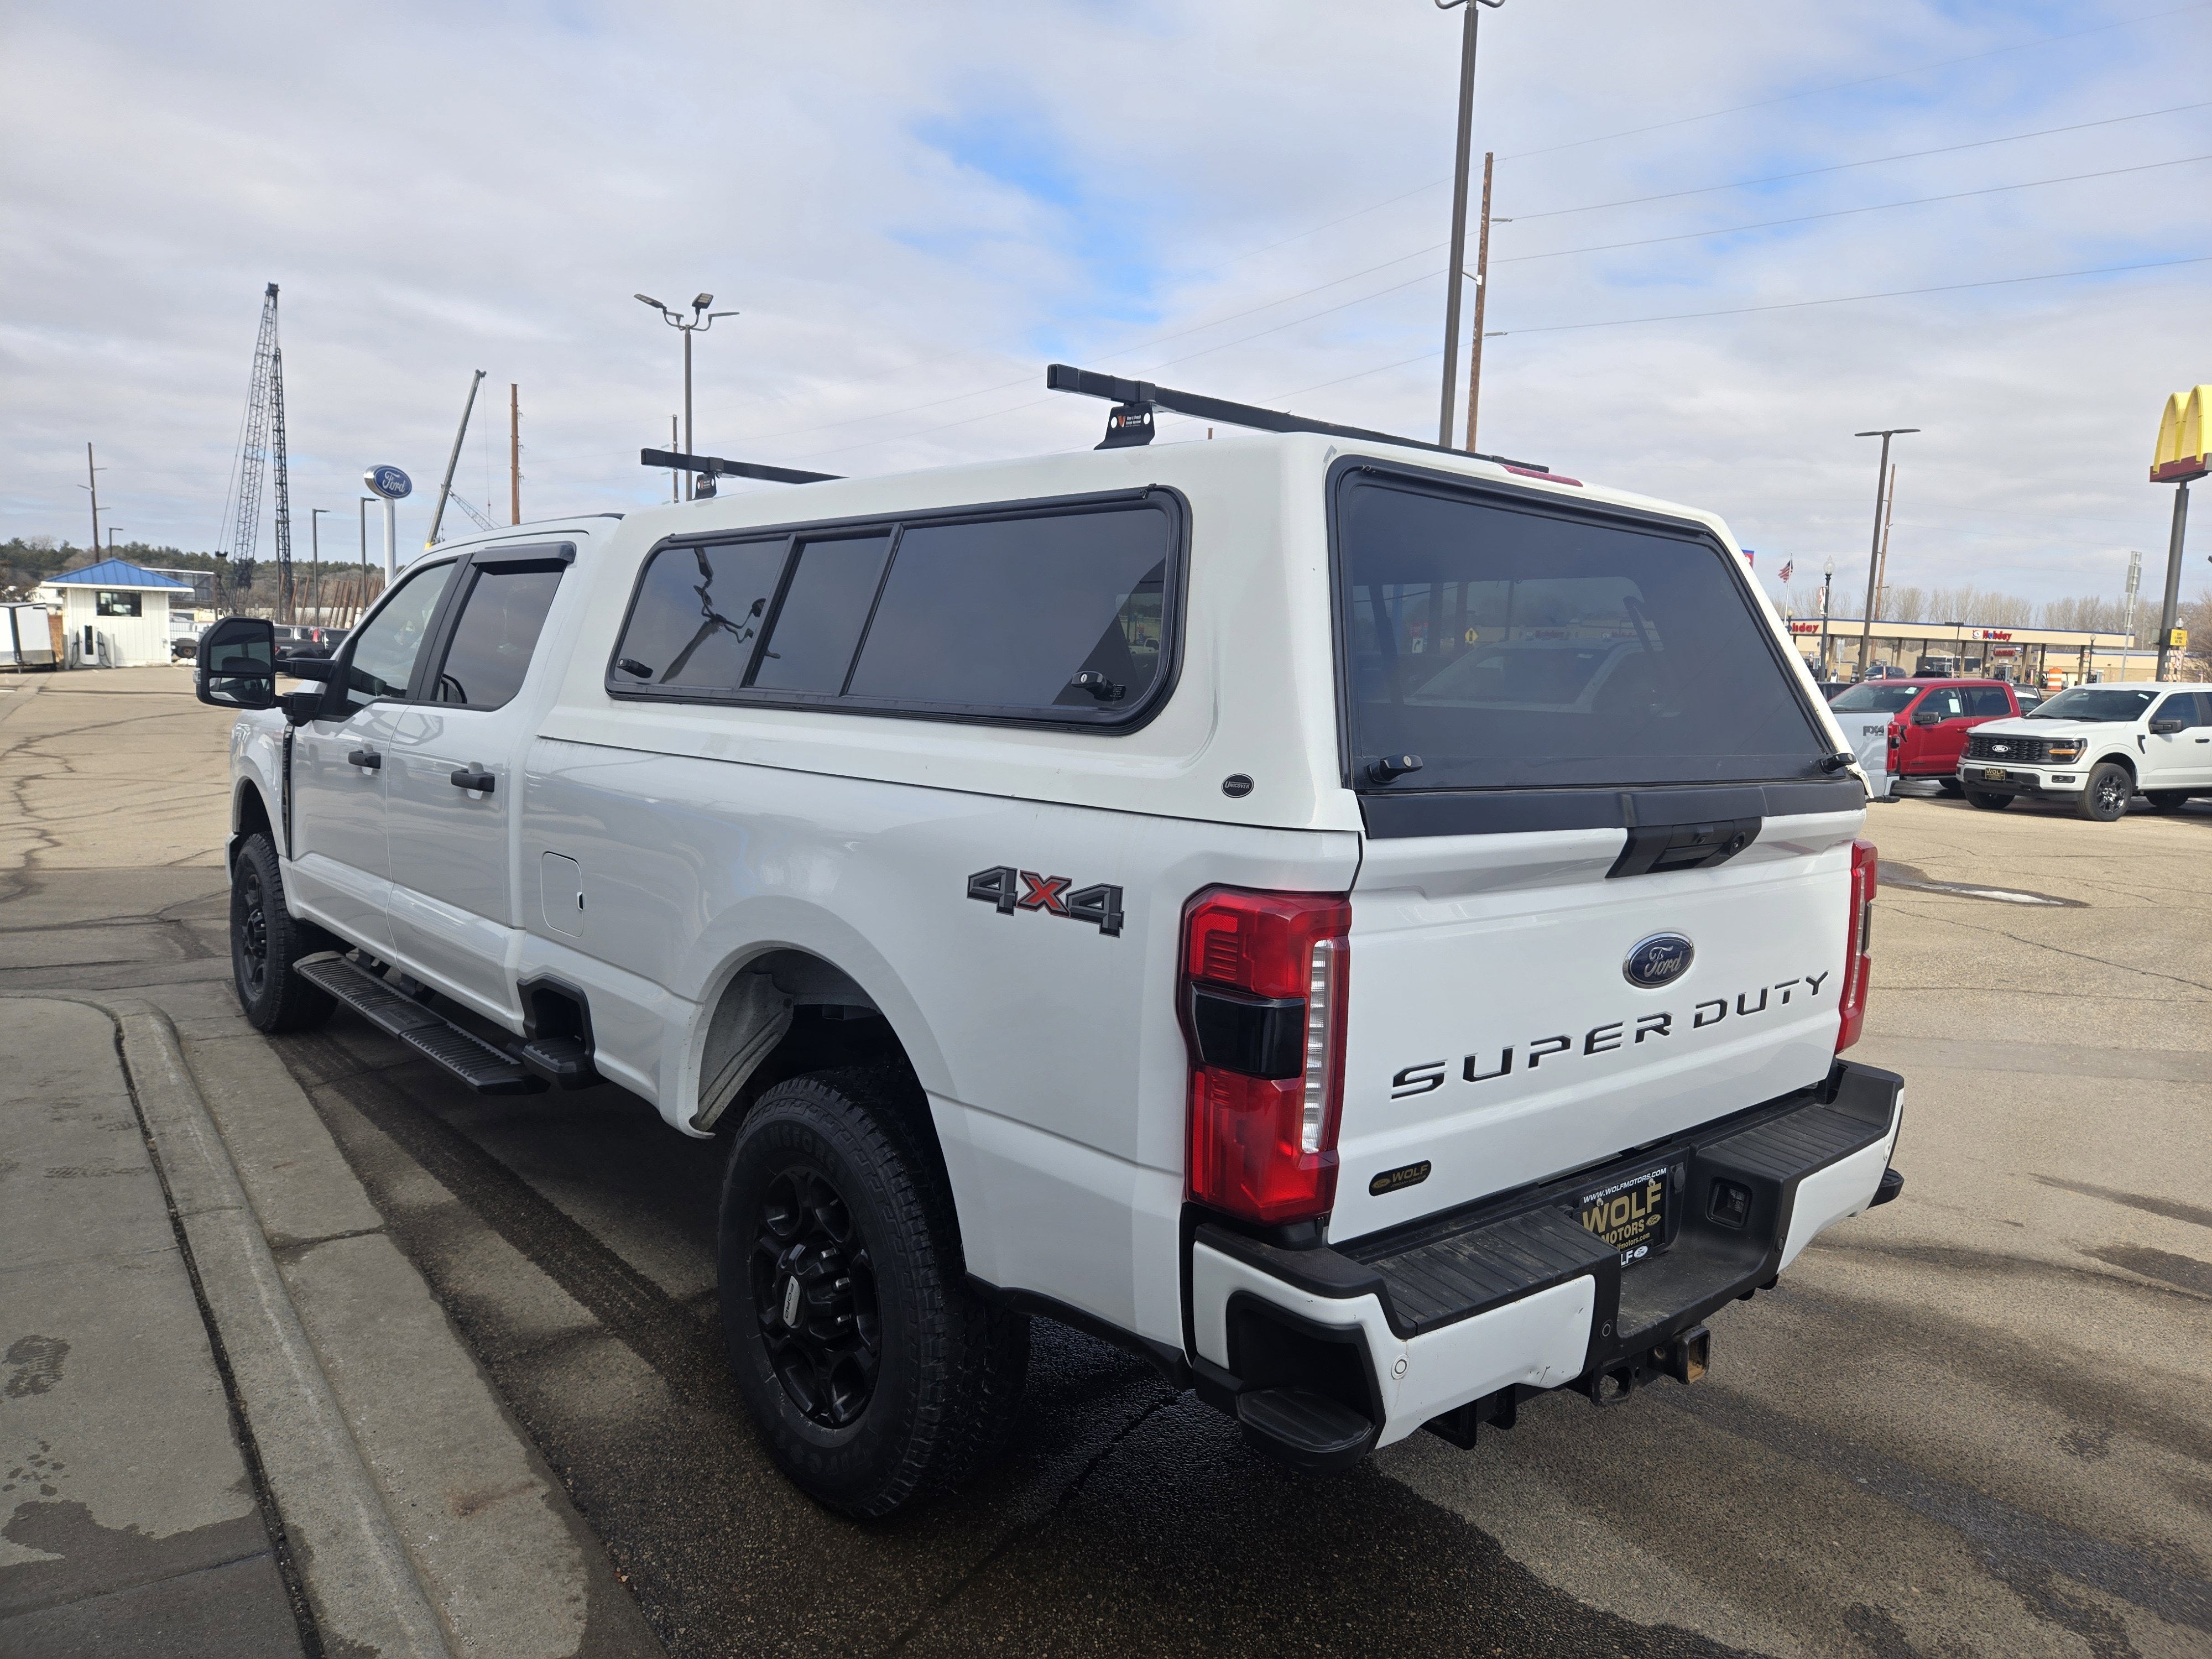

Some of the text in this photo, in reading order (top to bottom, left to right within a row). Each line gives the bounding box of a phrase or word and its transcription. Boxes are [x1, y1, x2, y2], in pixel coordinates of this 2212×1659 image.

[382, 471, 406, 493] Ford
[1863, 725, 1885, 737] FX4
[1644, 945, 1683, 978] Ford
[1391, 971, 1830, 1099] SUPER DUTY
[1392, 1164, 1428, 1182] WOLF
[1583, 1167, 1667, 1203] WWW.WOLFMOTORS.COM
[1582, 1182, 1662, 1233] WOLF
[1601, 1219, 1645, 1245] MOTORS
[785, 1283, 794, 1319] FORD
